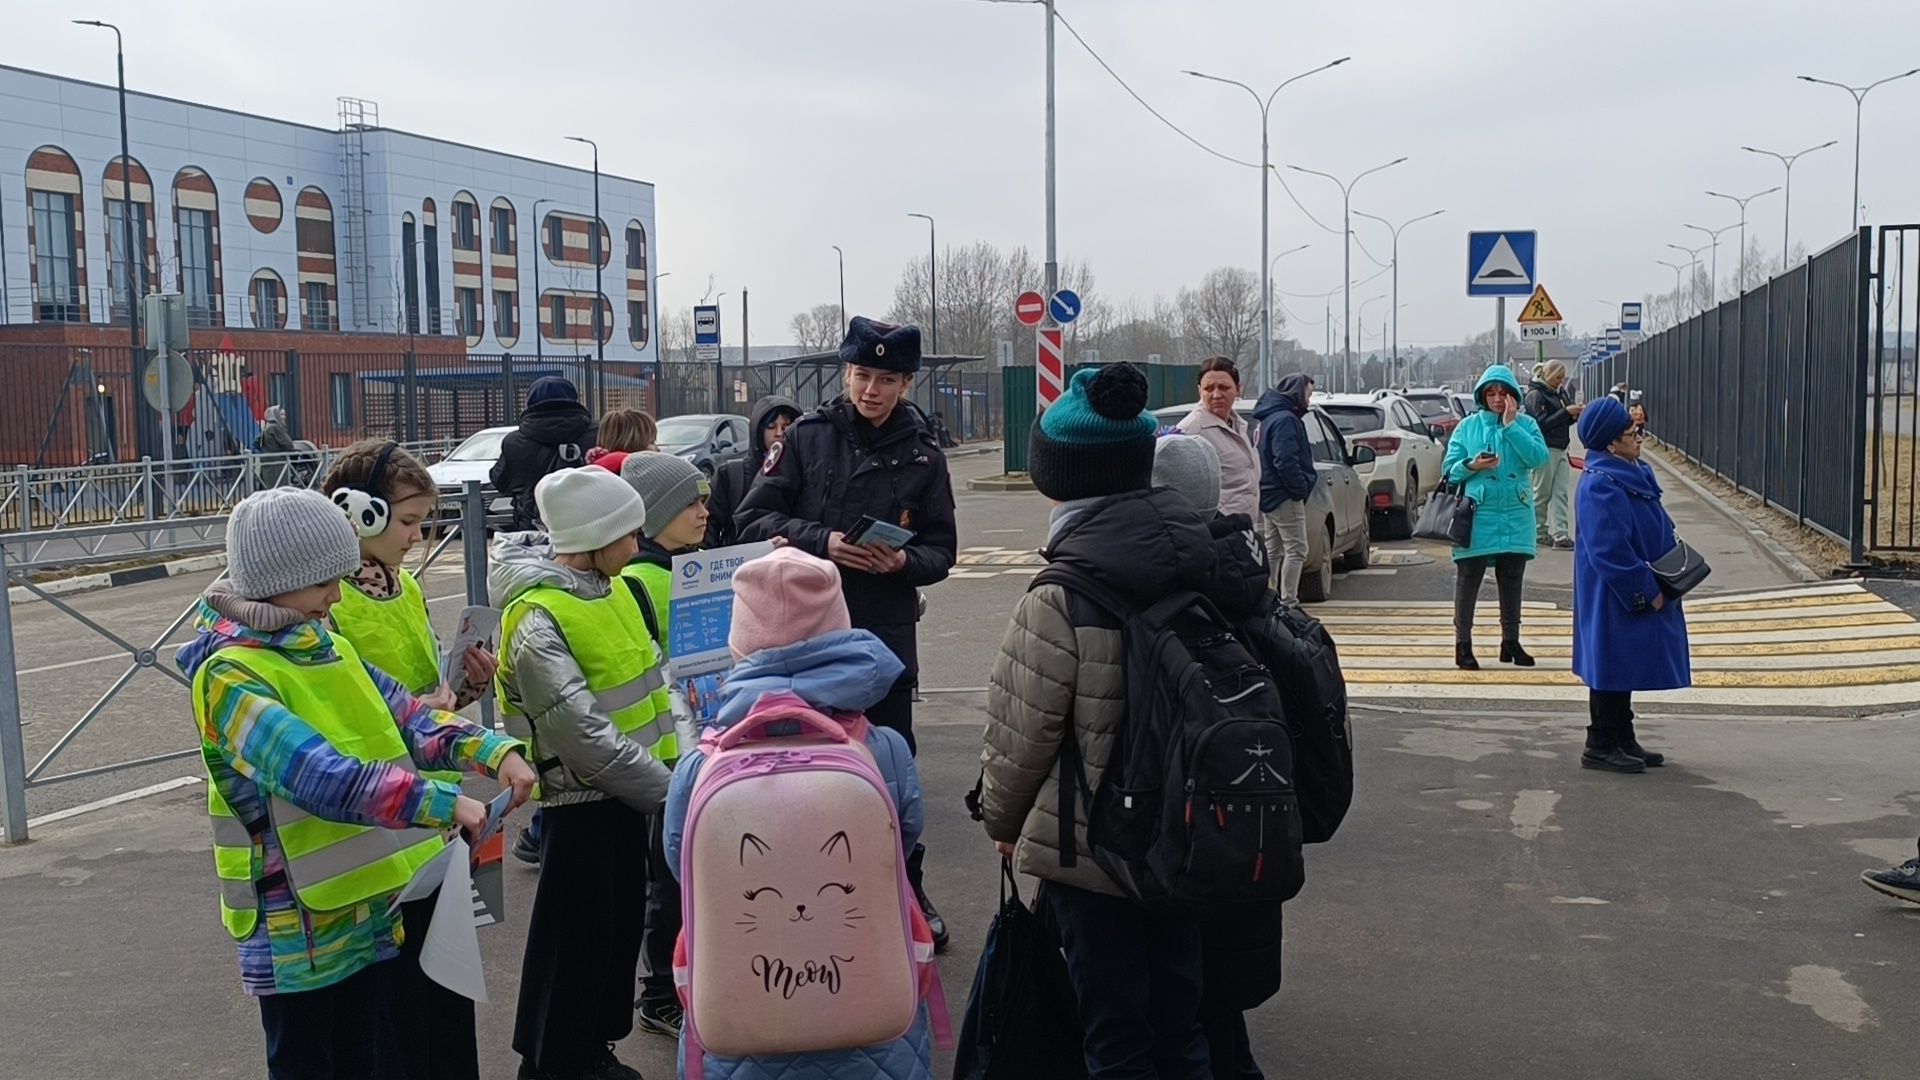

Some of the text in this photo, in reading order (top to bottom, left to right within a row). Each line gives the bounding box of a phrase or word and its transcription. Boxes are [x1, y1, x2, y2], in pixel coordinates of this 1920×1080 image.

[1530, 327, 1544, 335] 100
[710, 559, 724, 571] ГДЕ
[710, 570, 734, 583] ВНИМ
[751, 954, 855, 1000] Meow
